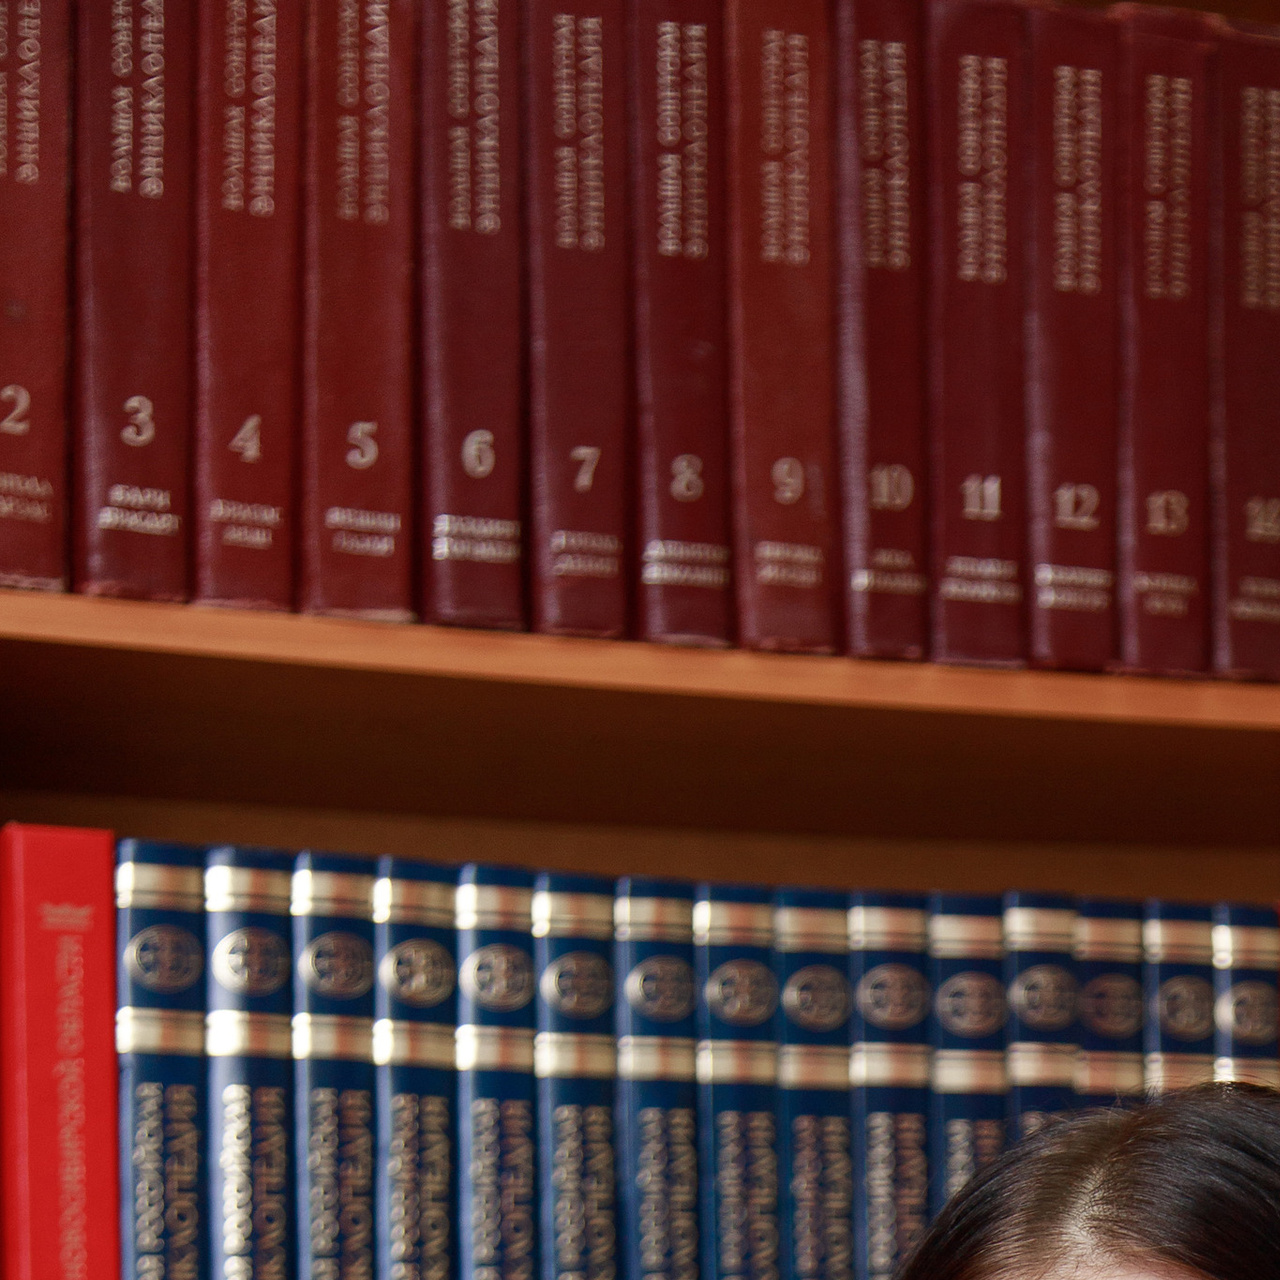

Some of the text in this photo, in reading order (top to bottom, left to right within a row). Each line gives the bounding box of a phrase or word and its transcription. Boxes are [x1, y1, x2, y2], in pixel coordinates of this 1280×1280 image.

[0, 384, 31, 435] 2
[121, 396, 156, 446] 3
[229, 415, 261, 463] 4
[346, 422, 378, 470] 5
[461, 429, 496, 479] 6
[570, 446, 601, 493] 7
[670, 455, 704, 502] 8
[771, 457, 804, 505] 9
[869, 464, 914, 511] 10
[961, 475, 1002, 520] 11
[1055, 484, 1100, 531] 12
[1146, 490, 1189, 535] 13
